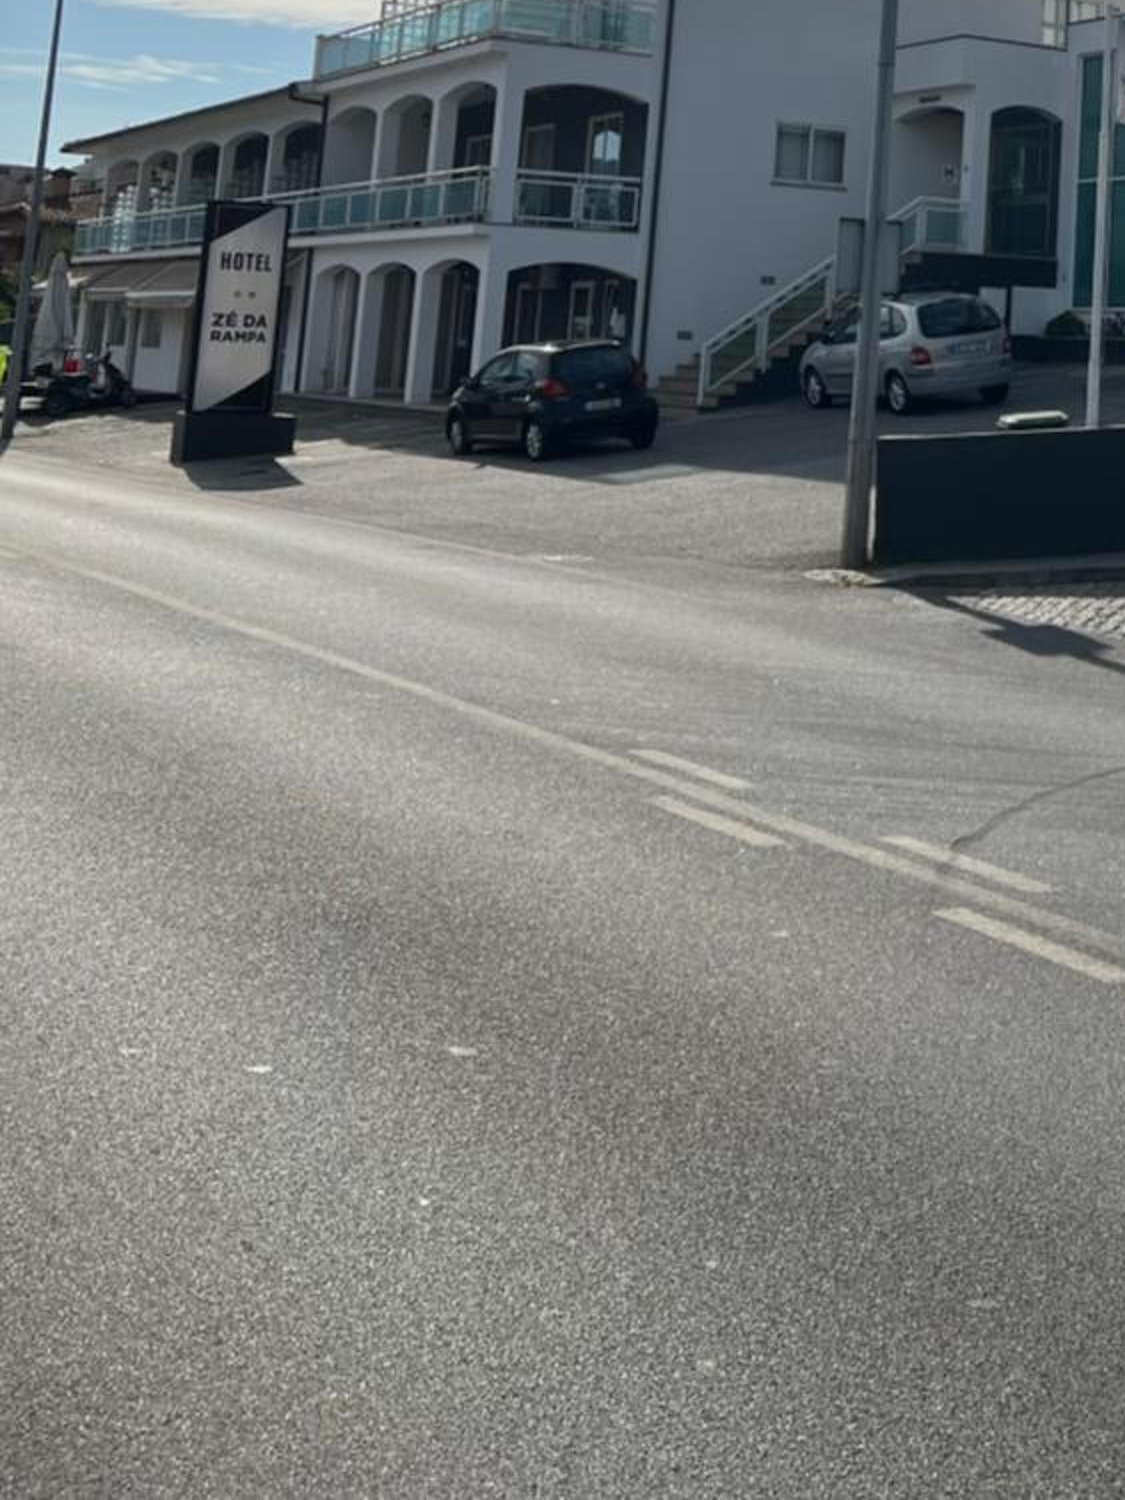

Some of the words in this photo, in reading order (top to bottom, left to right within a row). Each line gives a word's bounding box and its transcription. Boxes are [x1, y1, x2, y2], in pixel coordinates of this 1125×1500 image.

[221, 252, 272, 272] HOTEL
[210, 310, 238, 328] ZÉ
[243, 313, 267, 328] DA
[209, 330, 267, 343] RAMPA
